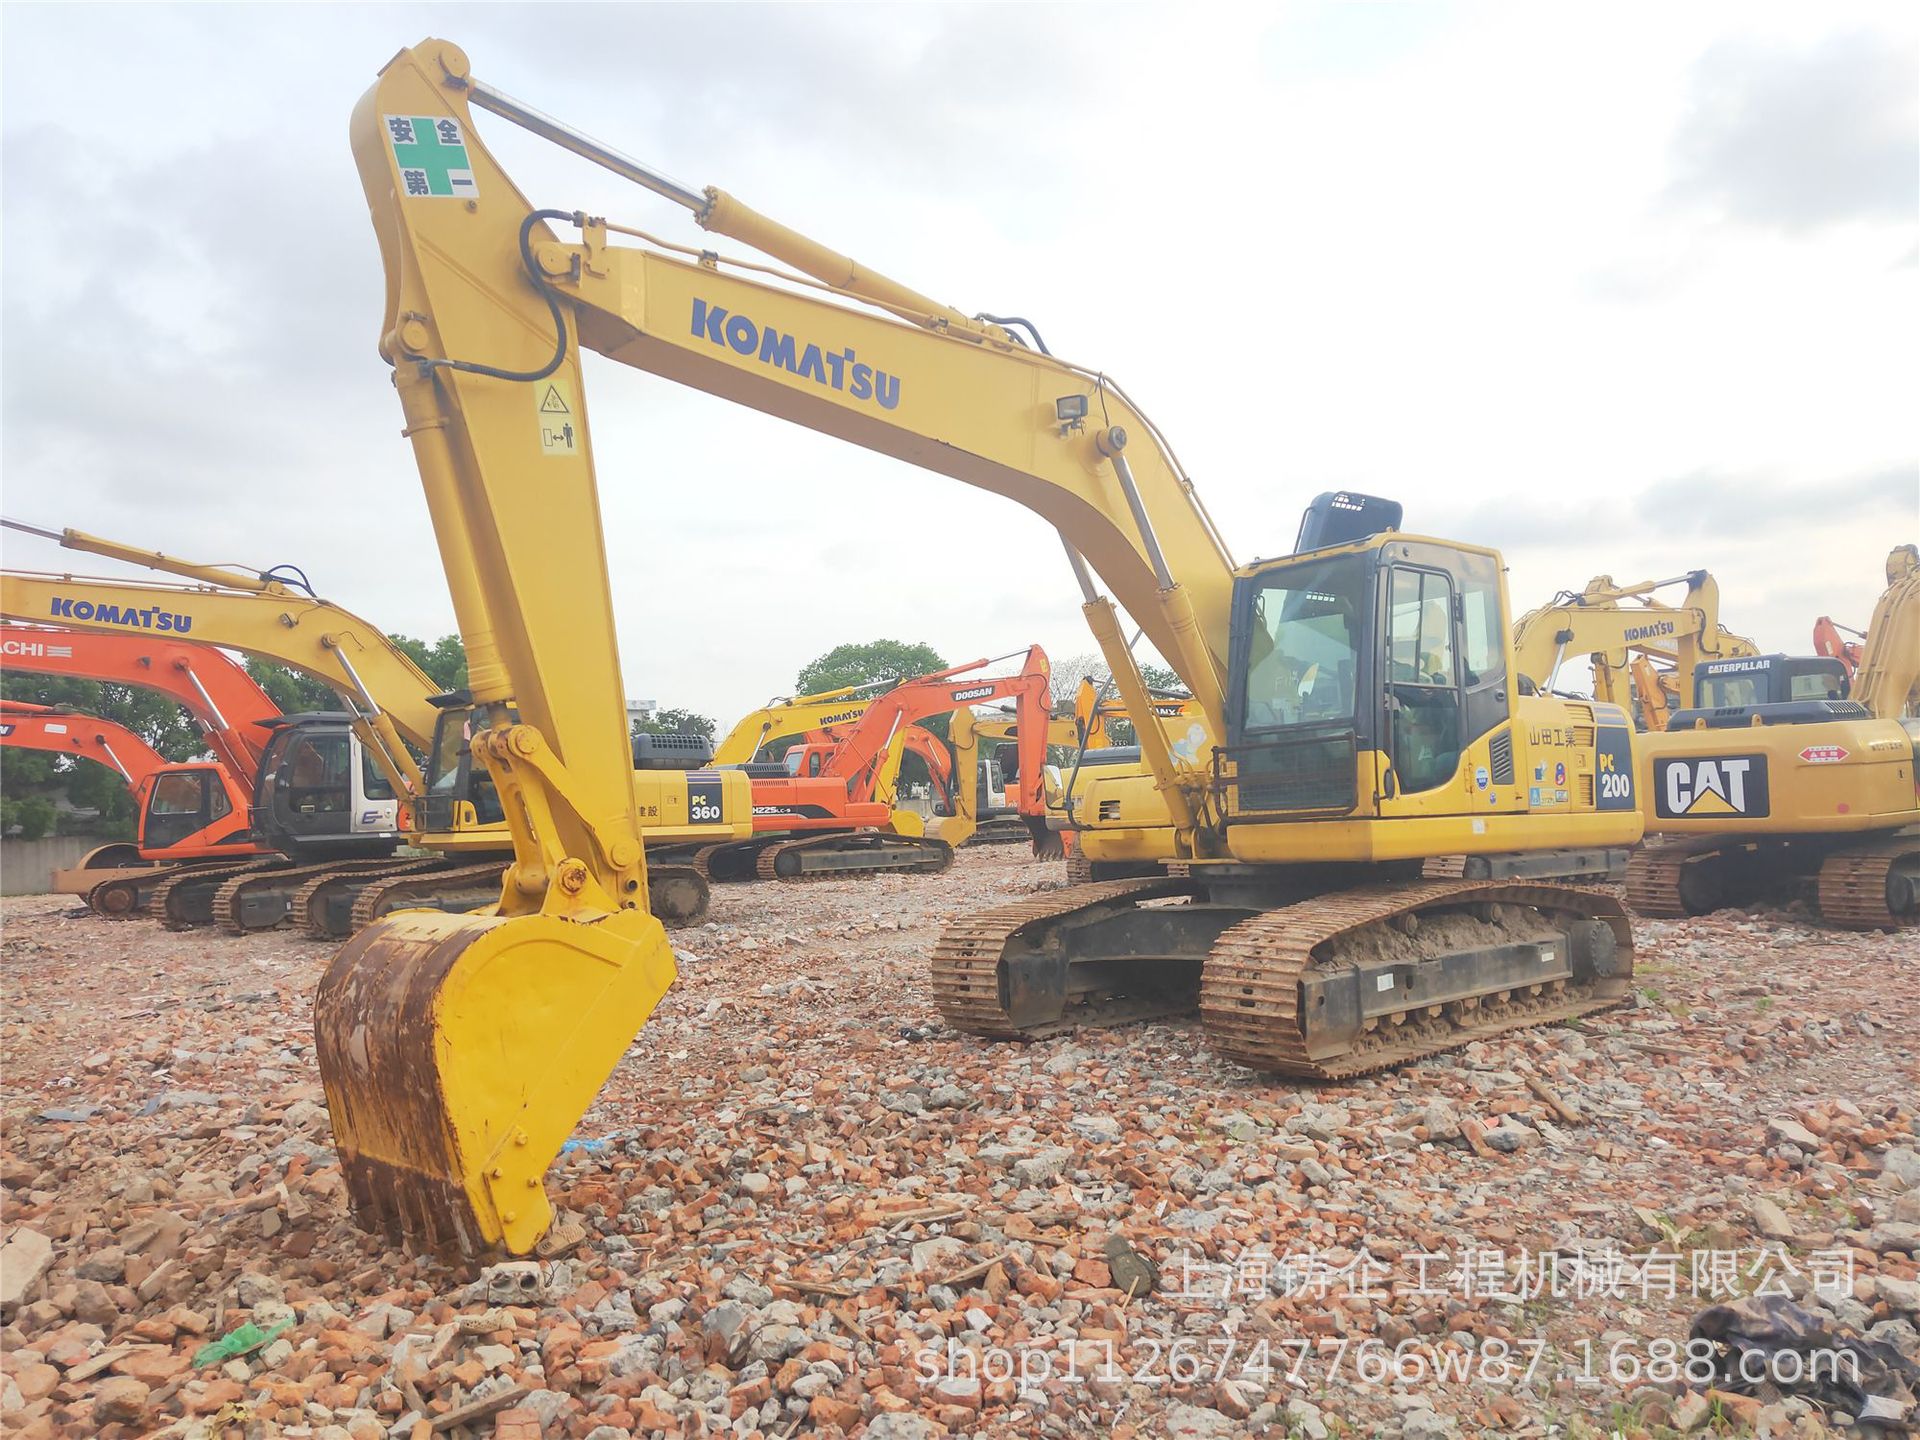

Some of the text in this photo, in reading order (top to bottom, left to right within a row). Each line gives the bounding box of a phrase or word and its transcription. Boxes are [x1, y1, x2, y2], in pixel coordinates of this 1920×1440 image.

[389, 118, 461, 144] 安全
[404, 170, 473, 195] 第一
[691, 297, 900, 410] KOMATSU
[51, 597, 192, 633] KOMATSU
[1624, 621, 1674, 642] KOMATSU
[1708, 660, 1770, 674] CATERPILLAR
[955, 687, 992, 700] DOOSAN
[820, 709, 864, 725] KOMATSU
[1600, 753, 1614, 772] PC
[1602, 773, 1630, 798] 200
[1666, 759, 1750, 814] CAT
[692, 795, 707, 806] PC
[691, 806, 720, 820] 360
